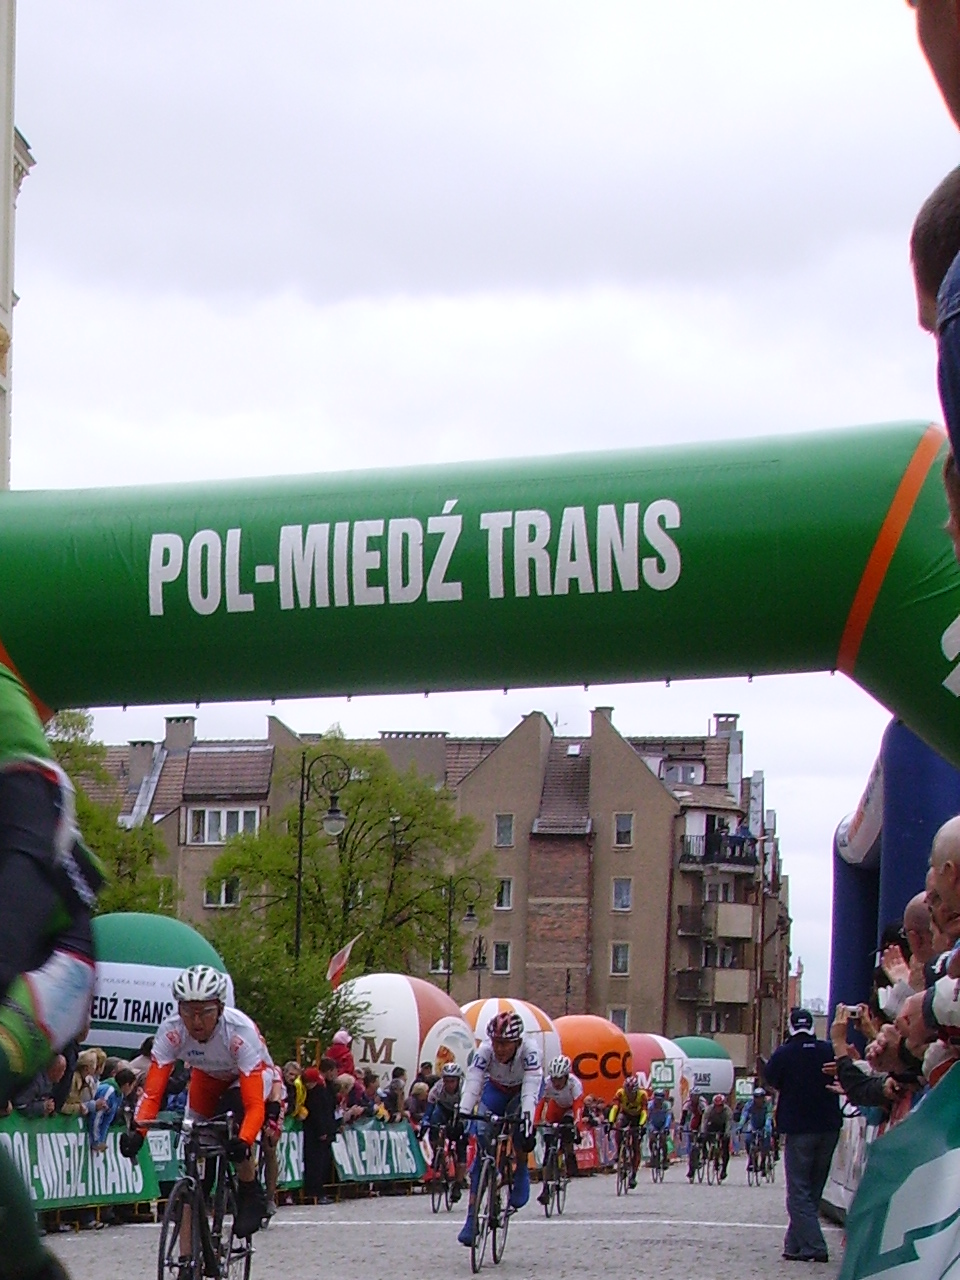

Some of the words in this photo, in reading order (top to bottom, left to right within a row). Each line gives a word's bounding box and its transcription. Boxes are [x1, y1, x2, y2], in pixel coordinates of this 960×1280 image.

[148, 500, 463, 617] POL-MIEDŹ
[480, 499, 682, 599] TRANS
[90, 992, 119, 1020] EDŹ
